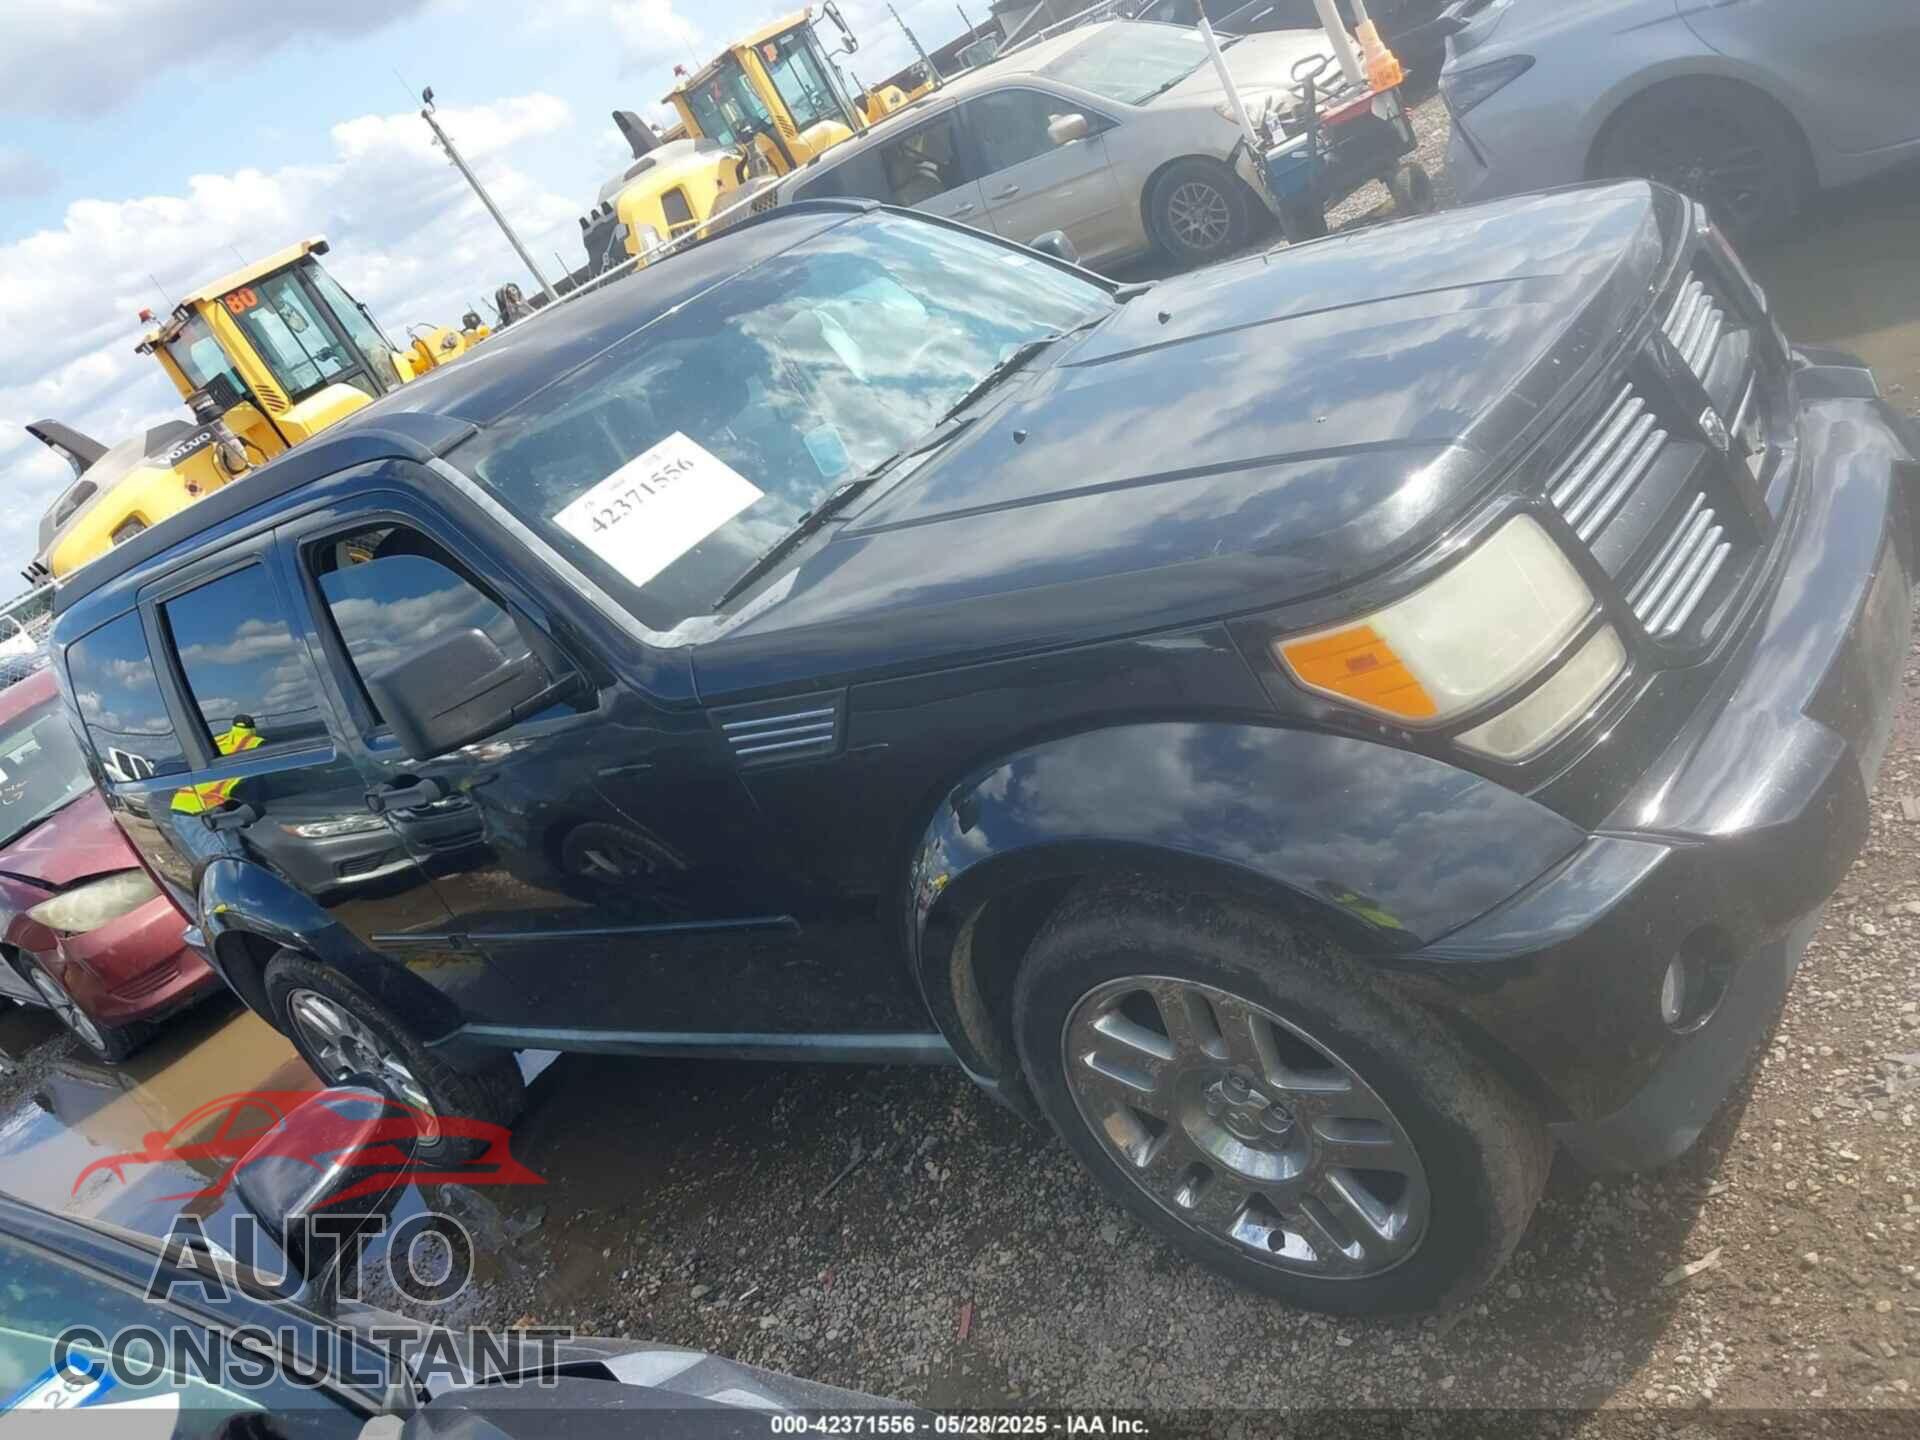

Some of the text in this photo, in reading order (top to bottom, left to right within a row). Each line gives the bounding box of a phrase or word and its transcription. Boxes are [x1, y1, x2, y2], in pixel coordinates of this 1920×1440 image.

[224, 287, 258, 314] 80
[157, 432, 212, 465] VOLVO
[591, 457, 696, 533] 42371556
